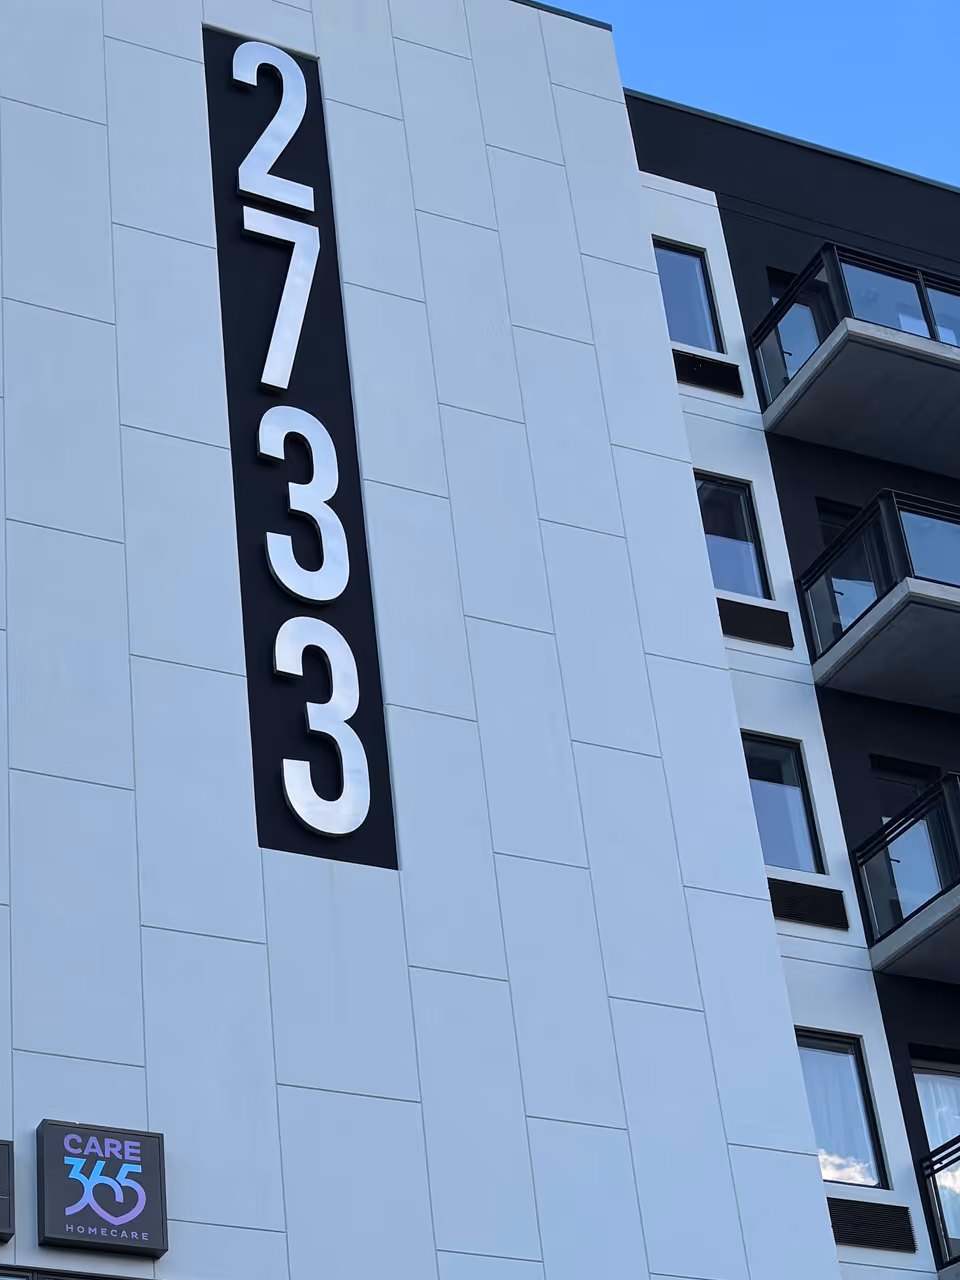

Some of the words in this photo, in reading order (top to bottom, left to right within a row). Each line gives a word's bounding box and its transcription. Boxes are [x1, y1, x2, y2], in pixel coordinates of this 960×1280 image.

[231, 39, 371, 838] 2733
[63, 1133, 141, 1161] CARE
[63, 1156, 147, 1226] 365
[65, 1223, 149, 1241] HOMECARE
